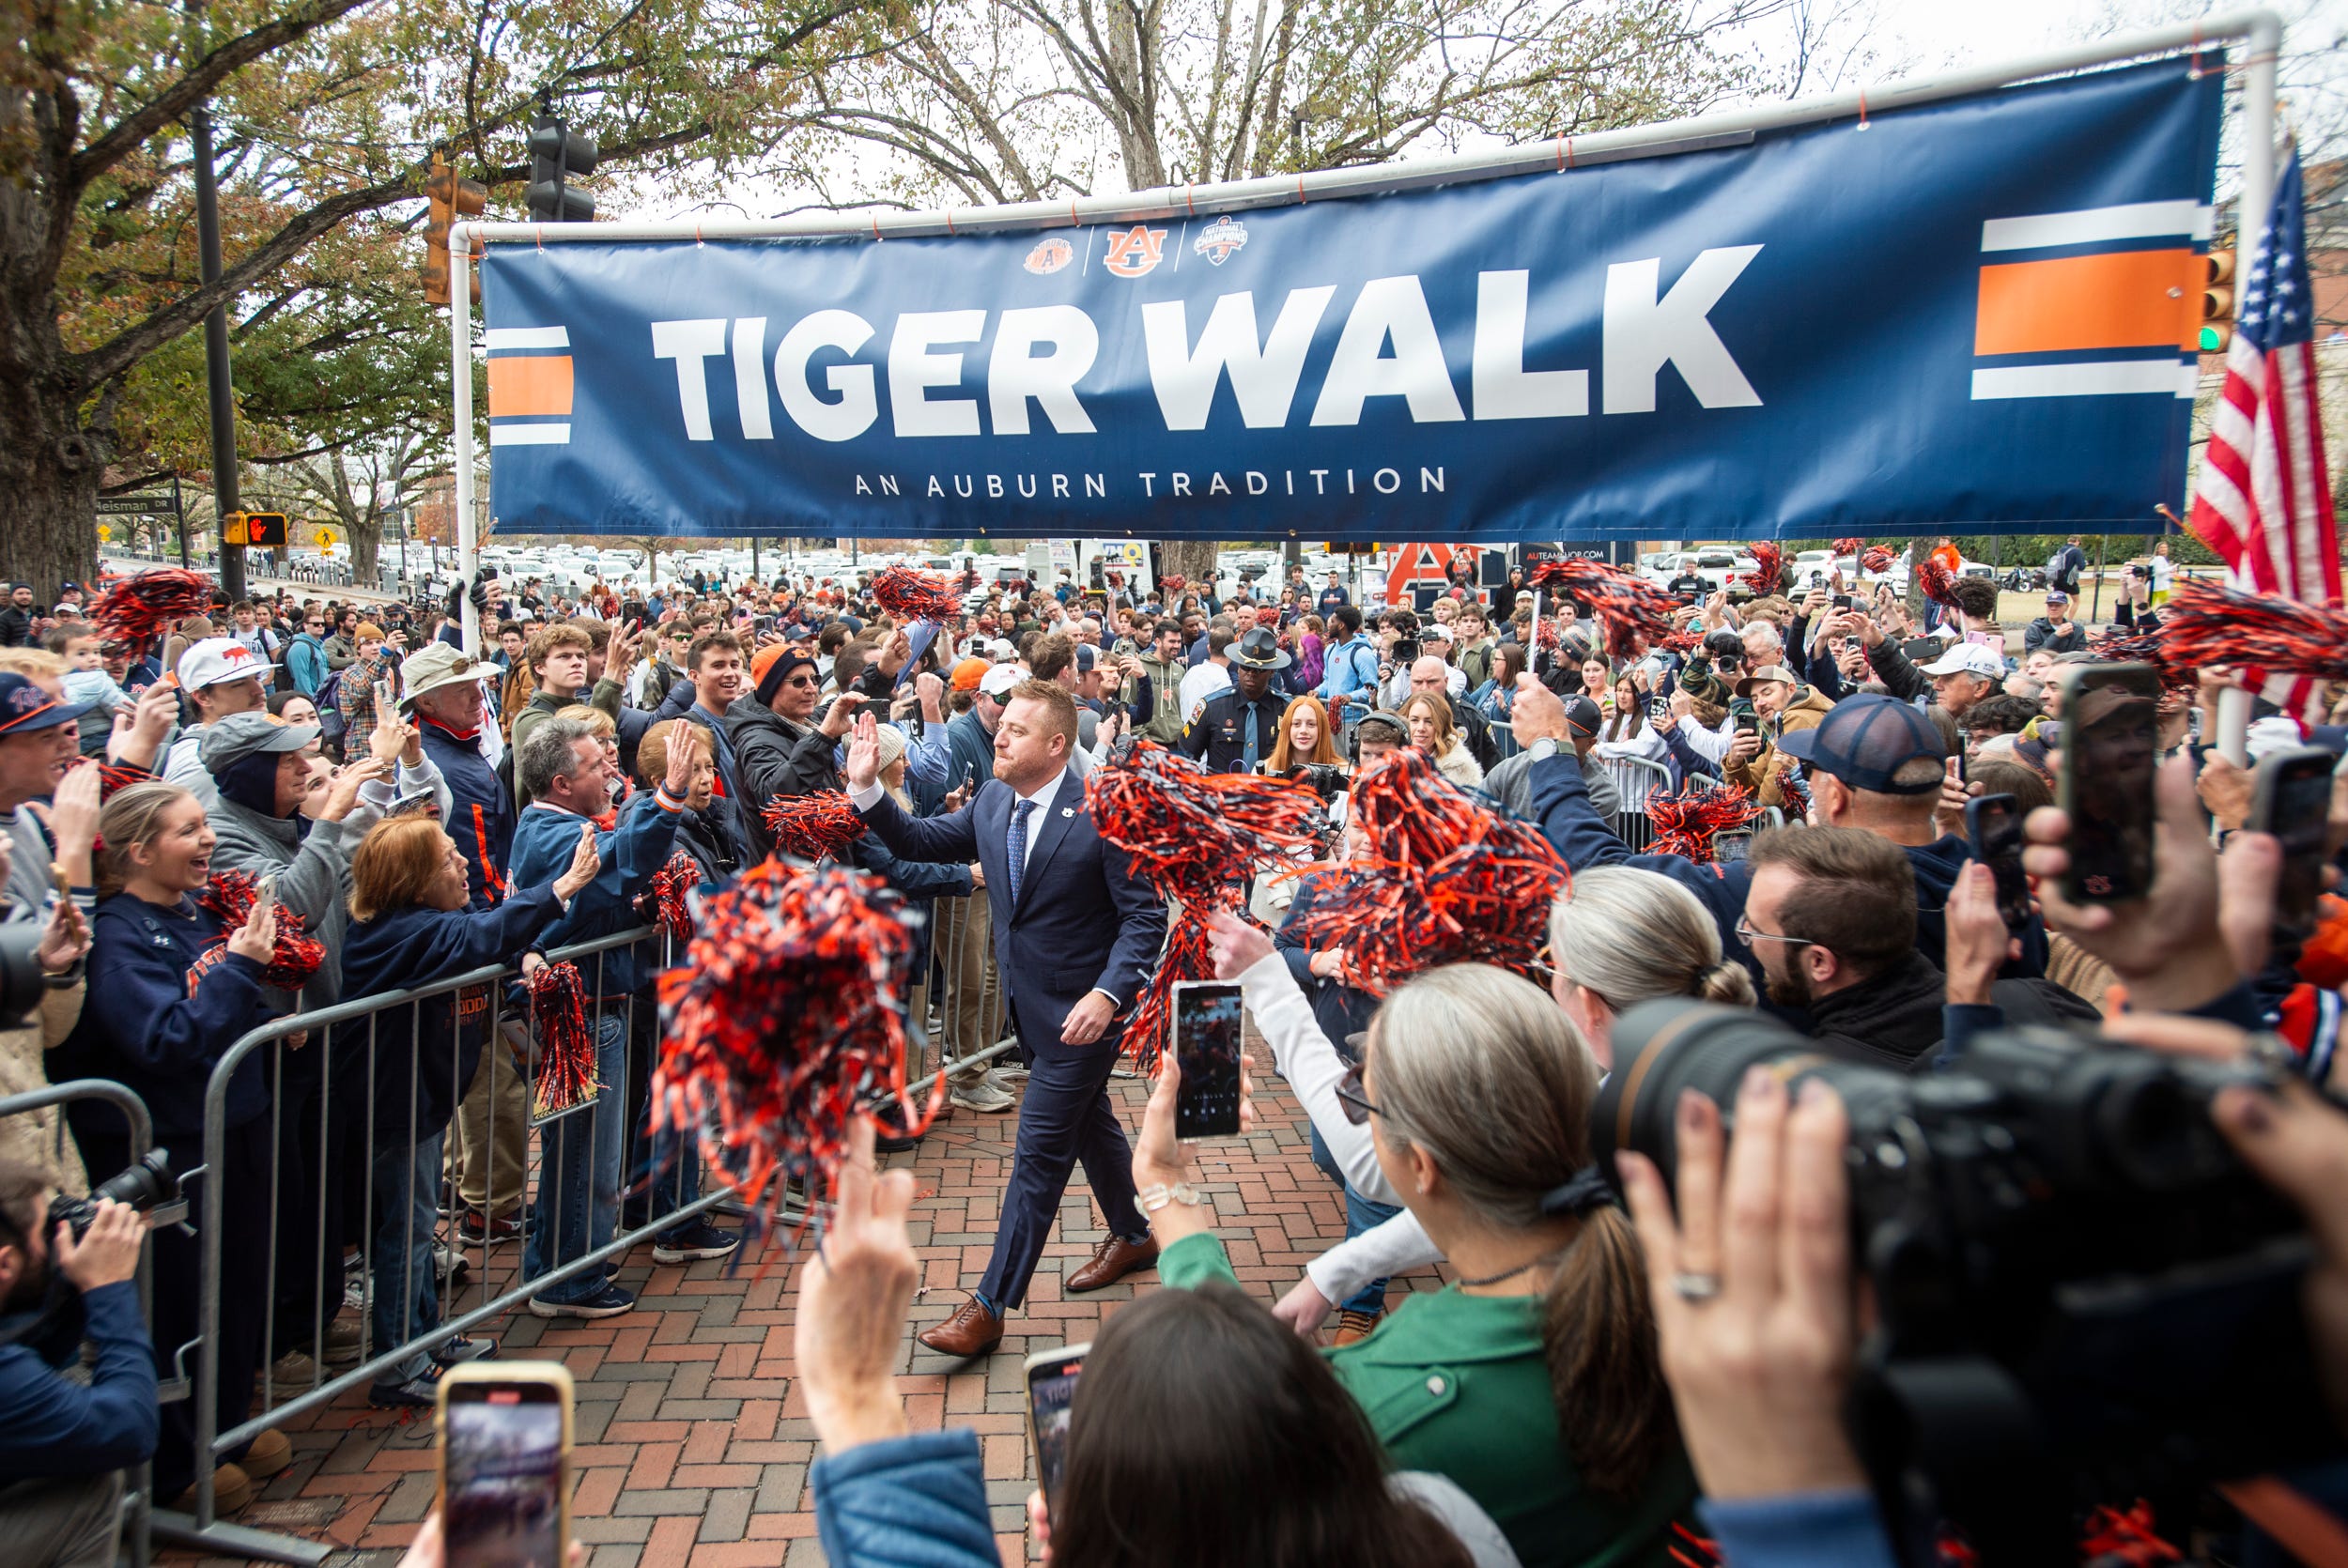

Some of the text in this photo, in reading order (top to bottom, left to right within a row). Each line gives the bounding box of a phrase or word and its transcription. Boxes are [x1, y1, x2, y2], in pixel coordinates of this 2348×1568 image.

[651, 243, 1765, 442] TIGER WALK
[855, 467, 1445, 499] AN AUBURN TRADITION
[155, 500, 168, 508] DR
[1000, 1060, 1024, 1069] HOKA
